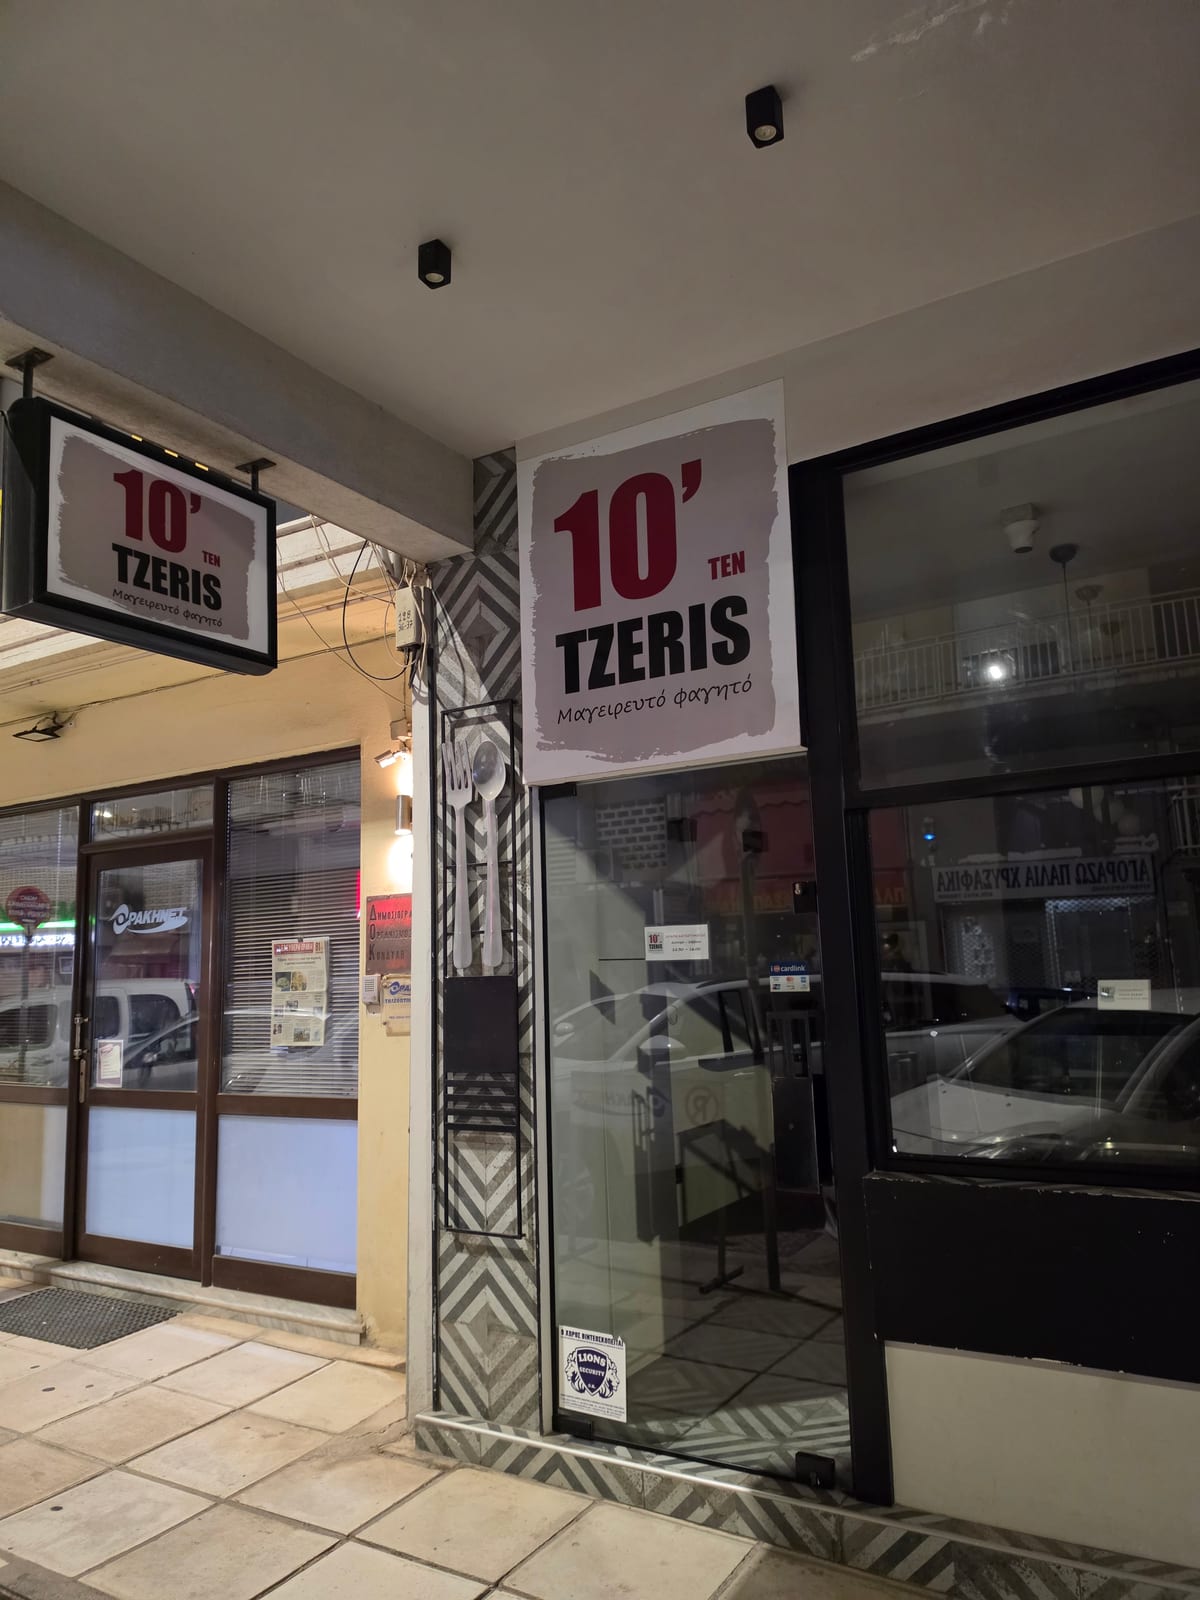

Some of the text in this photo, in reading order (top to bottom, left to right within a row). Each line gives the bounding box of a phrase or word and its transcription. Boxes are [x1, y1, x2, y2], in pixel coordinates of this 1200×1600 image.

[202, 550, 221, 567] TEN
[707, 550, 746, 580] TEN
[112, 542, 222, 611] TZERIS
[112, 587, 223, 628] Μαγειρευτό φαγητό
[555, 595, 750, 694] TZERIS
[557, 673, 752, 724] Μαγειρευτό φαγητό
[781, 964, 806, 972] cardlink
[578, 1353, 606, 1367] LIONS
[579, 1367, 605, 1377] SECURITY
